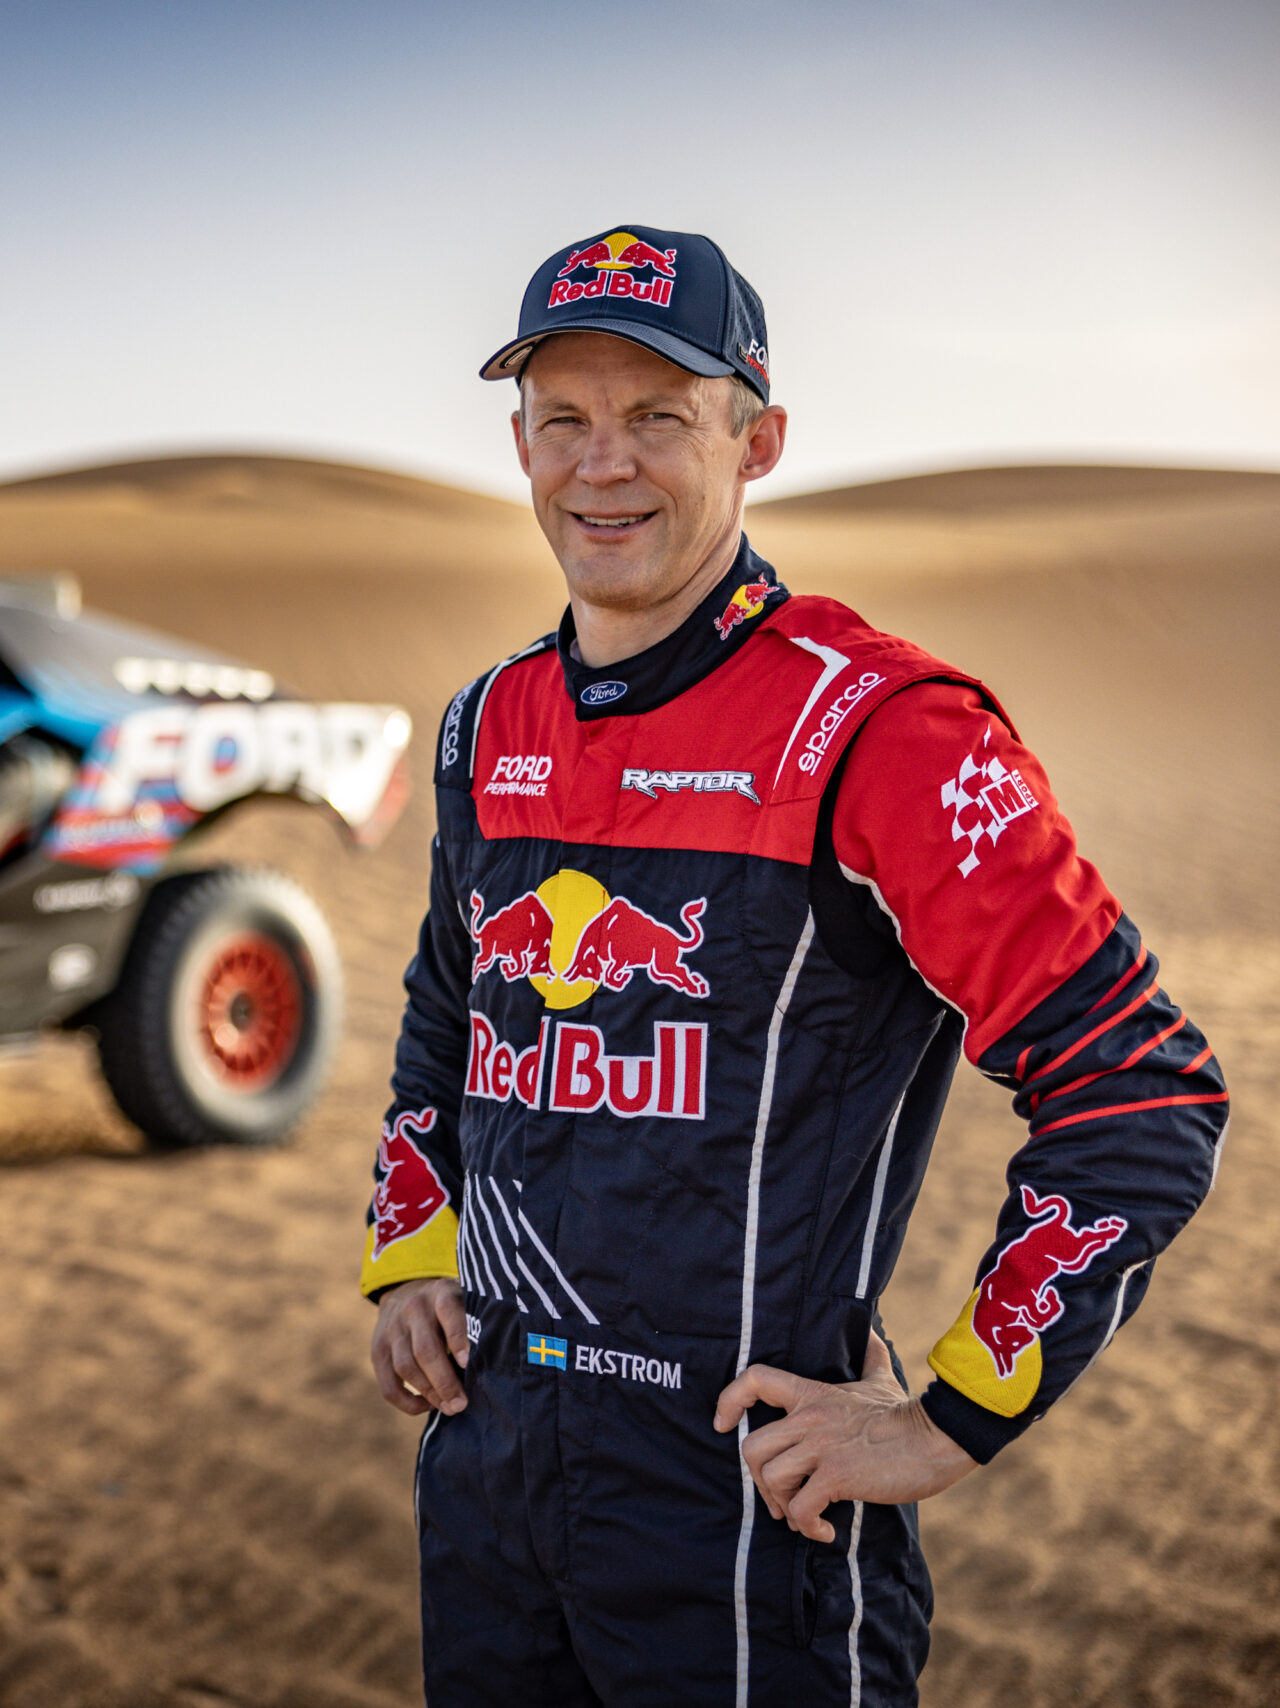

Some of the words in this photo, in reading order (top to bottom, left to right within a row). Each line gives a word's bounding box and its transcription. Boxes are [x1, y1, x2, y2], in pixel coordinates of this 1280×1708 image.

[548, 270, 607, 308] Red
[605, 270, 674, 307] Bull
[748, 338, 769, 376] FO
[589, 684, 619, 702] Ford
[798, 672, 882, 774] sparco
[96, 702, 404, 822] FORD
[491, 755, 552, 781] FORD
[621, 768, 761, 805] RAPTOR
[1013, 773, 1036, 805] SPORT
[465, 1010, 550, 1111] Red
[549, 1021, 708, 1120] Bull
[575, 1344, 681, 1390] EKSTROM
